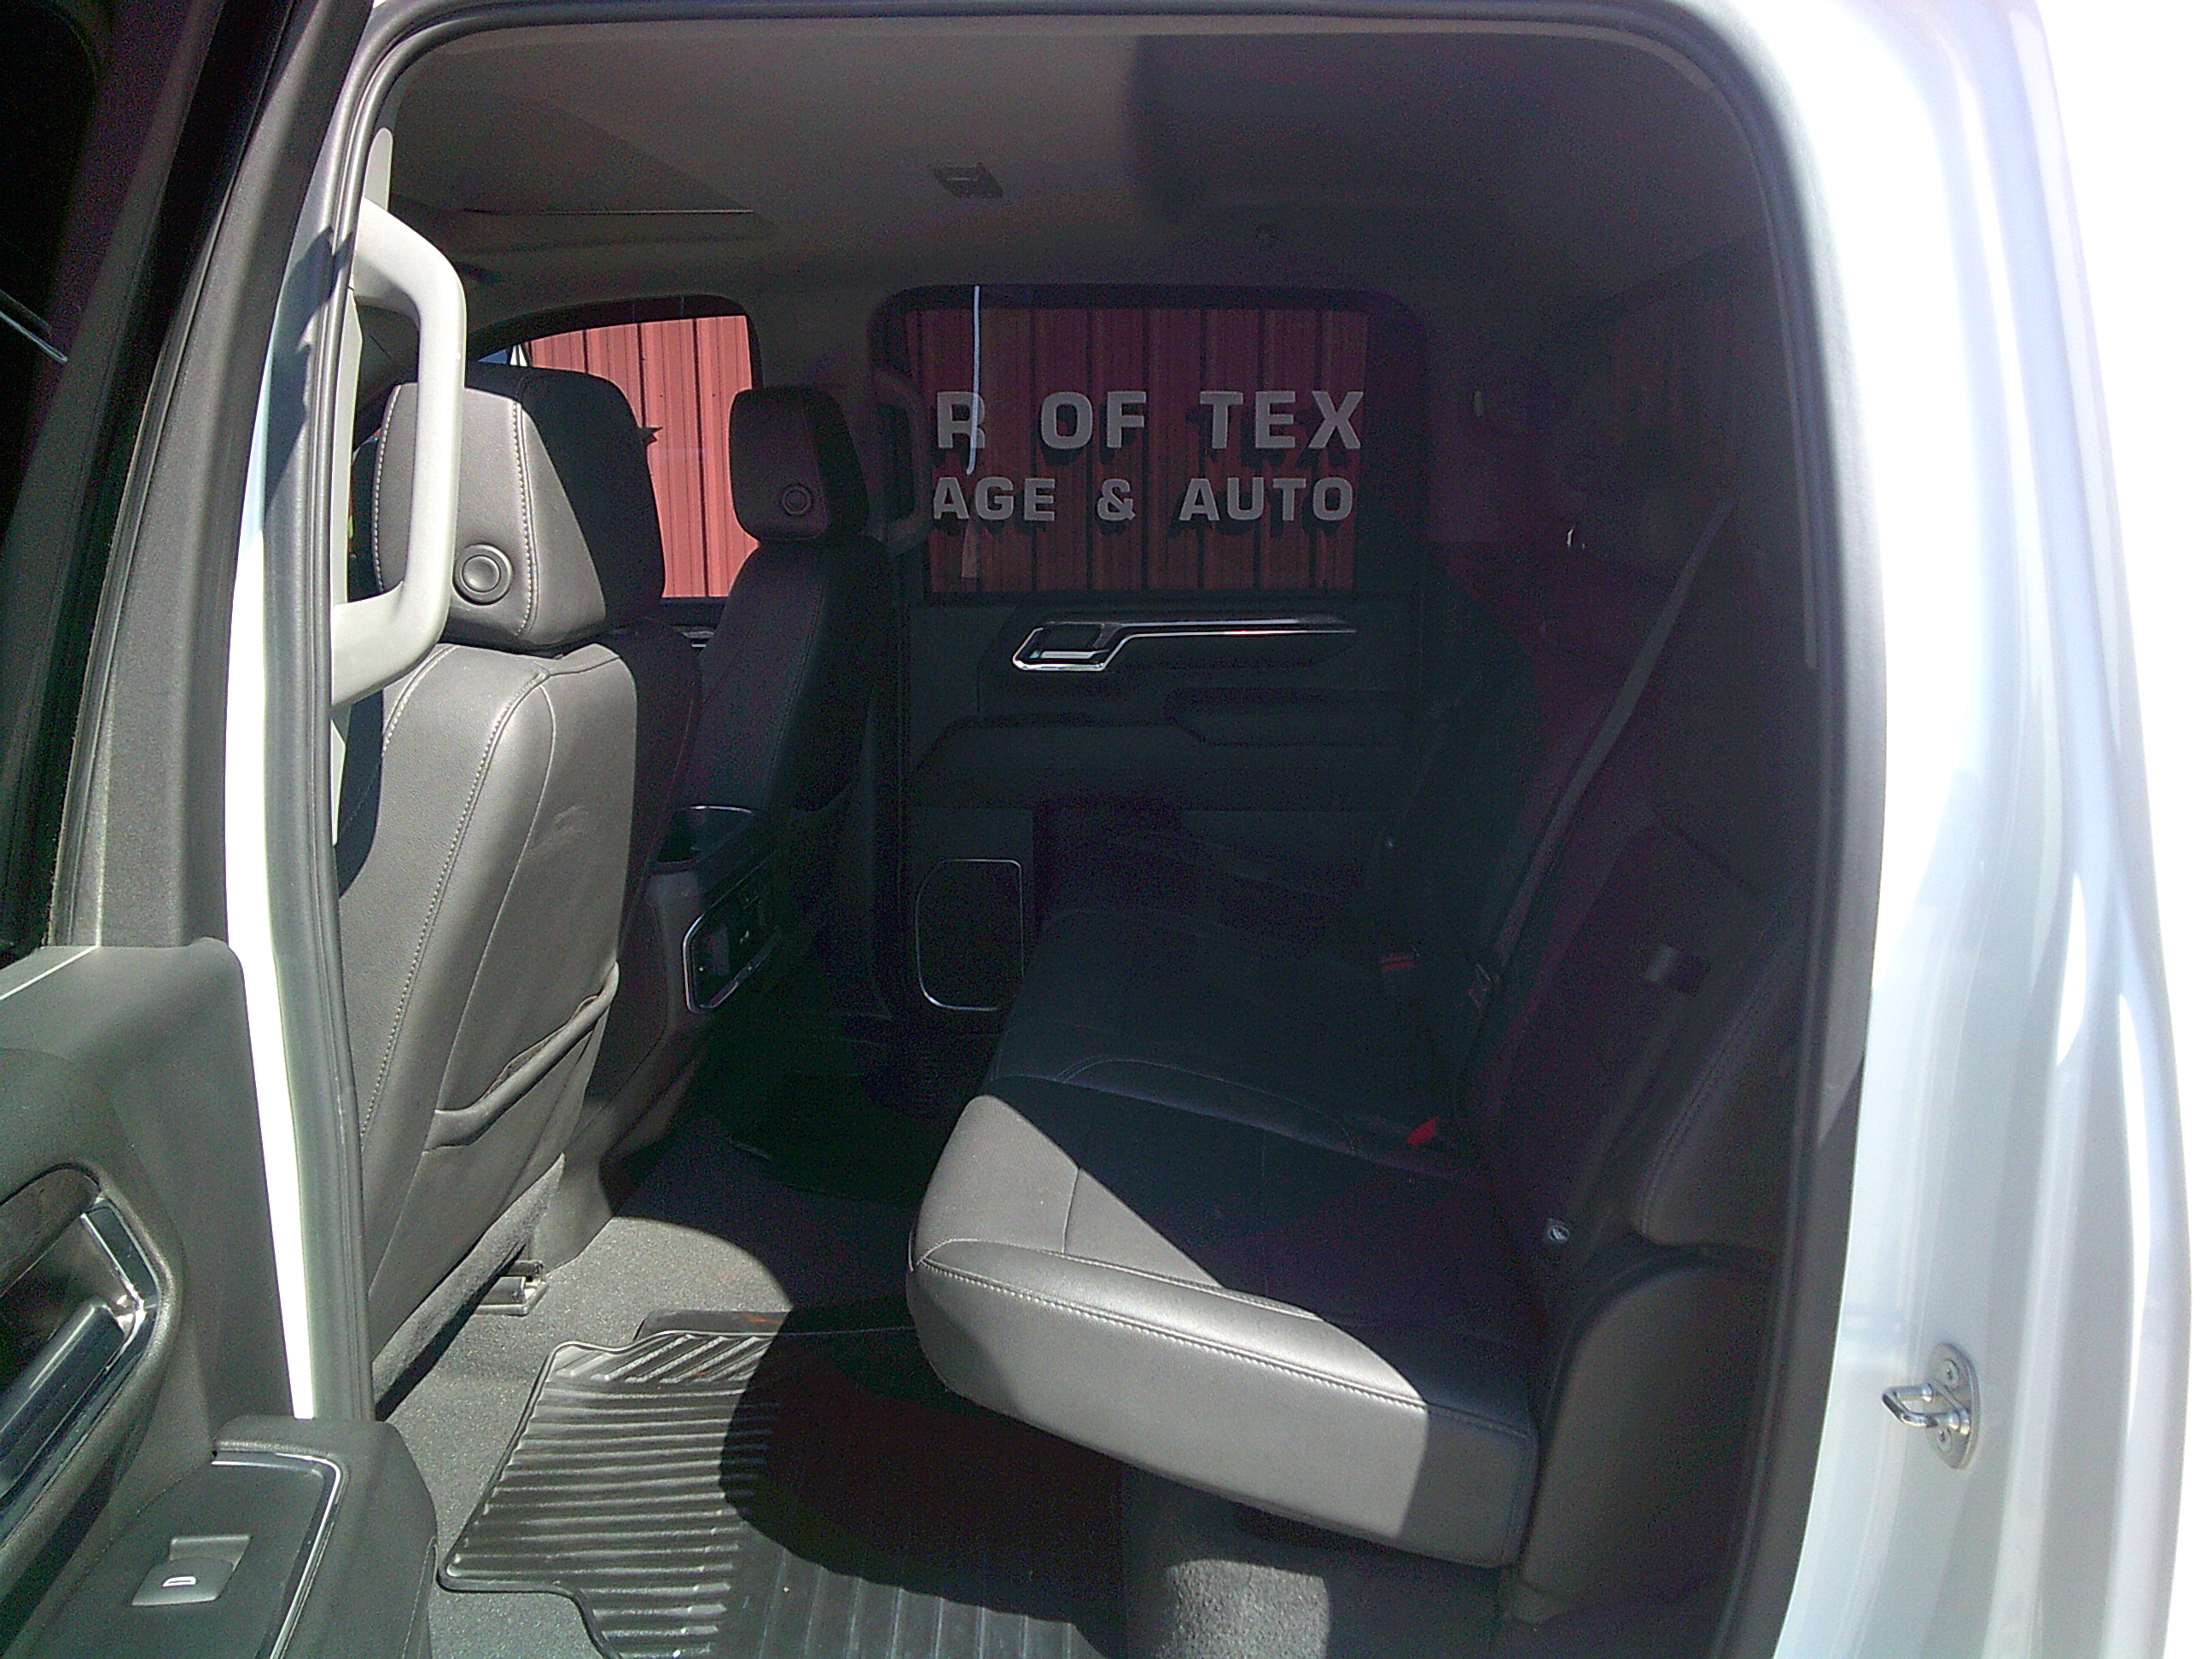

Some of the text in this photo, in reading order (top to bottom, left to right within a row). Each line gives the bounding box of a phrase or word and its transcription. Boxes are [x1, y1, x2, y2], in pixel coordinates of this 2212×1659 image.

[936, 391, 1364, 450] R OF TEX
[933, 476, 1354, 521] AGE & AUTO
